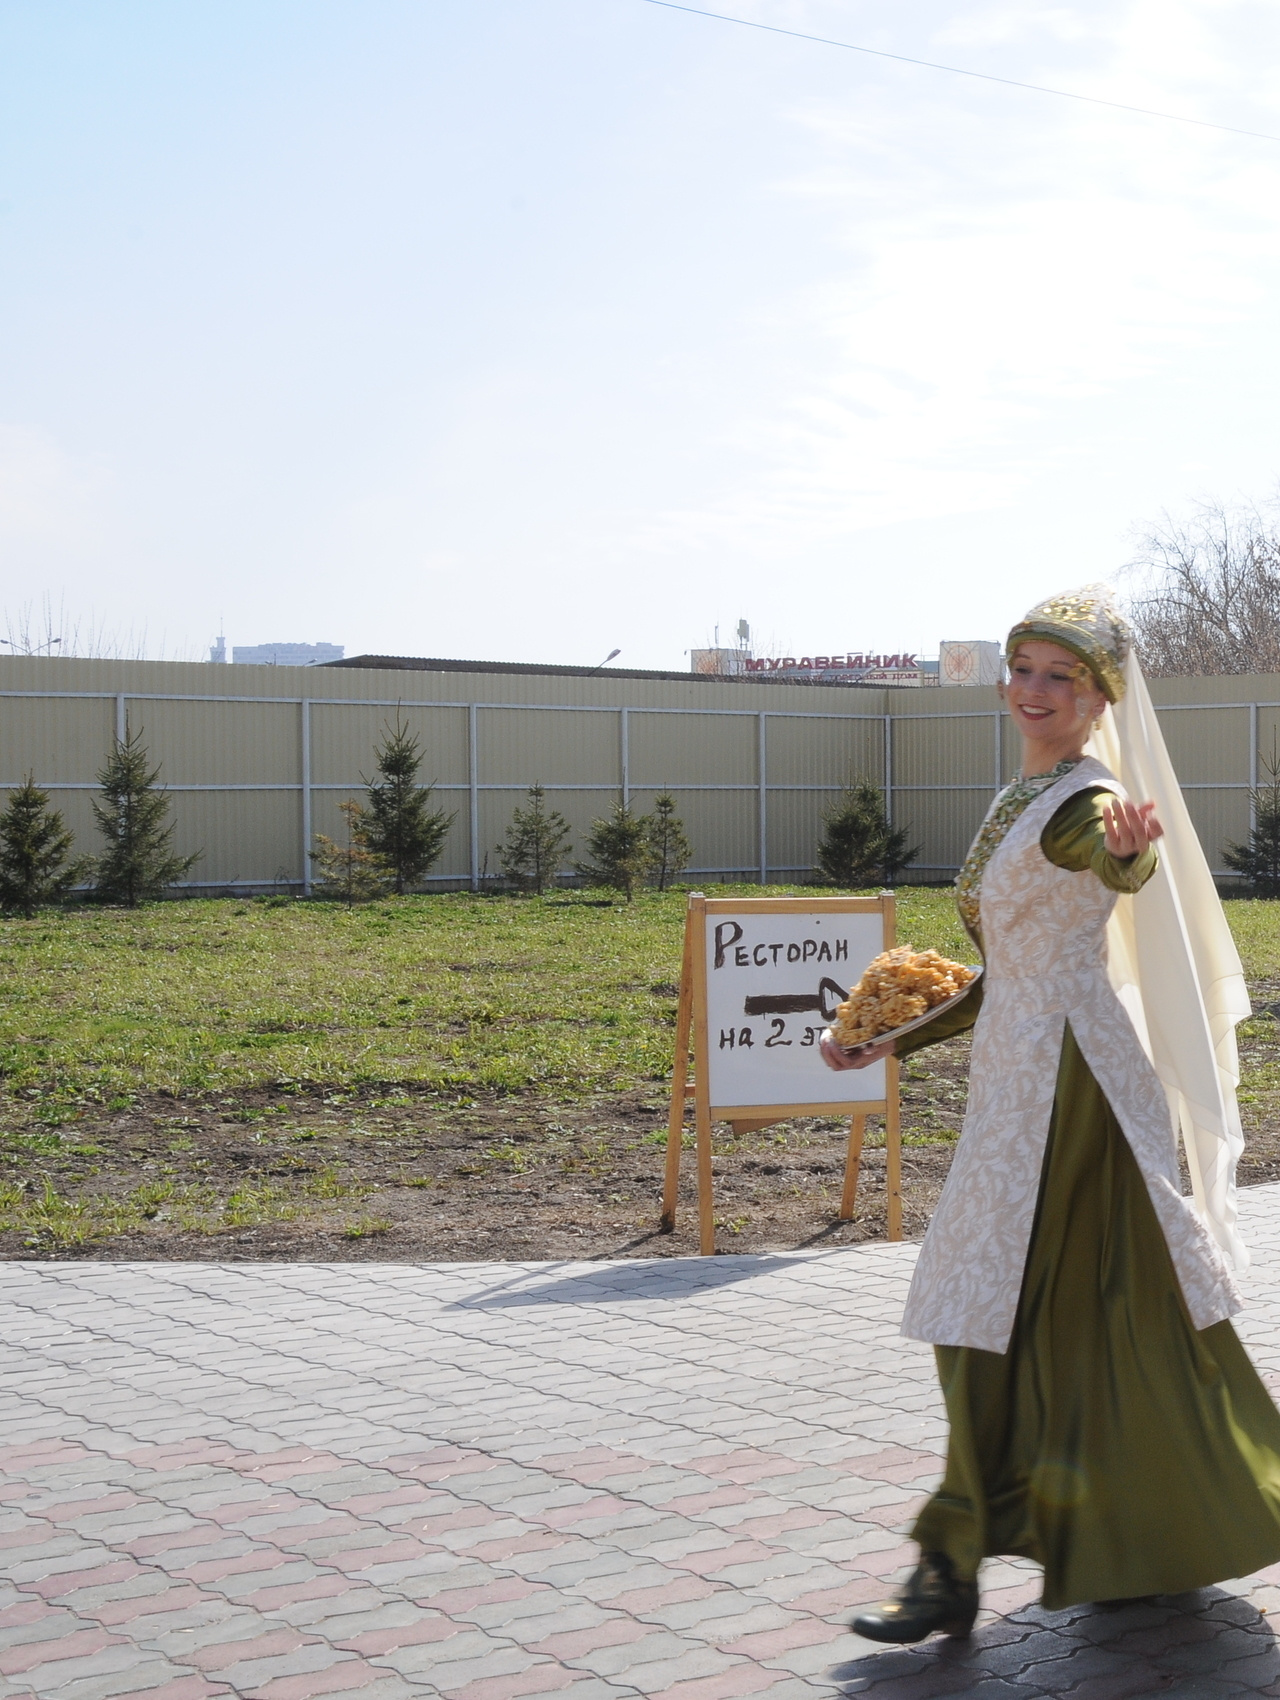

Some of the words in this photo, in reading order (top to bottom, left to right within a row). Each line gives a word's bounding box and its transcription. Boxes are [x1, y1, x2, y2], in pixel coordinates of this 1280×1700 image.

[745, 652, 919, 671] МУРАВЕЙНИК
[714, 921, 848, 970] РЕСТОРАН
[719, 1027, 754, 1050] на
[764, 1018, 792, 1047] 2
